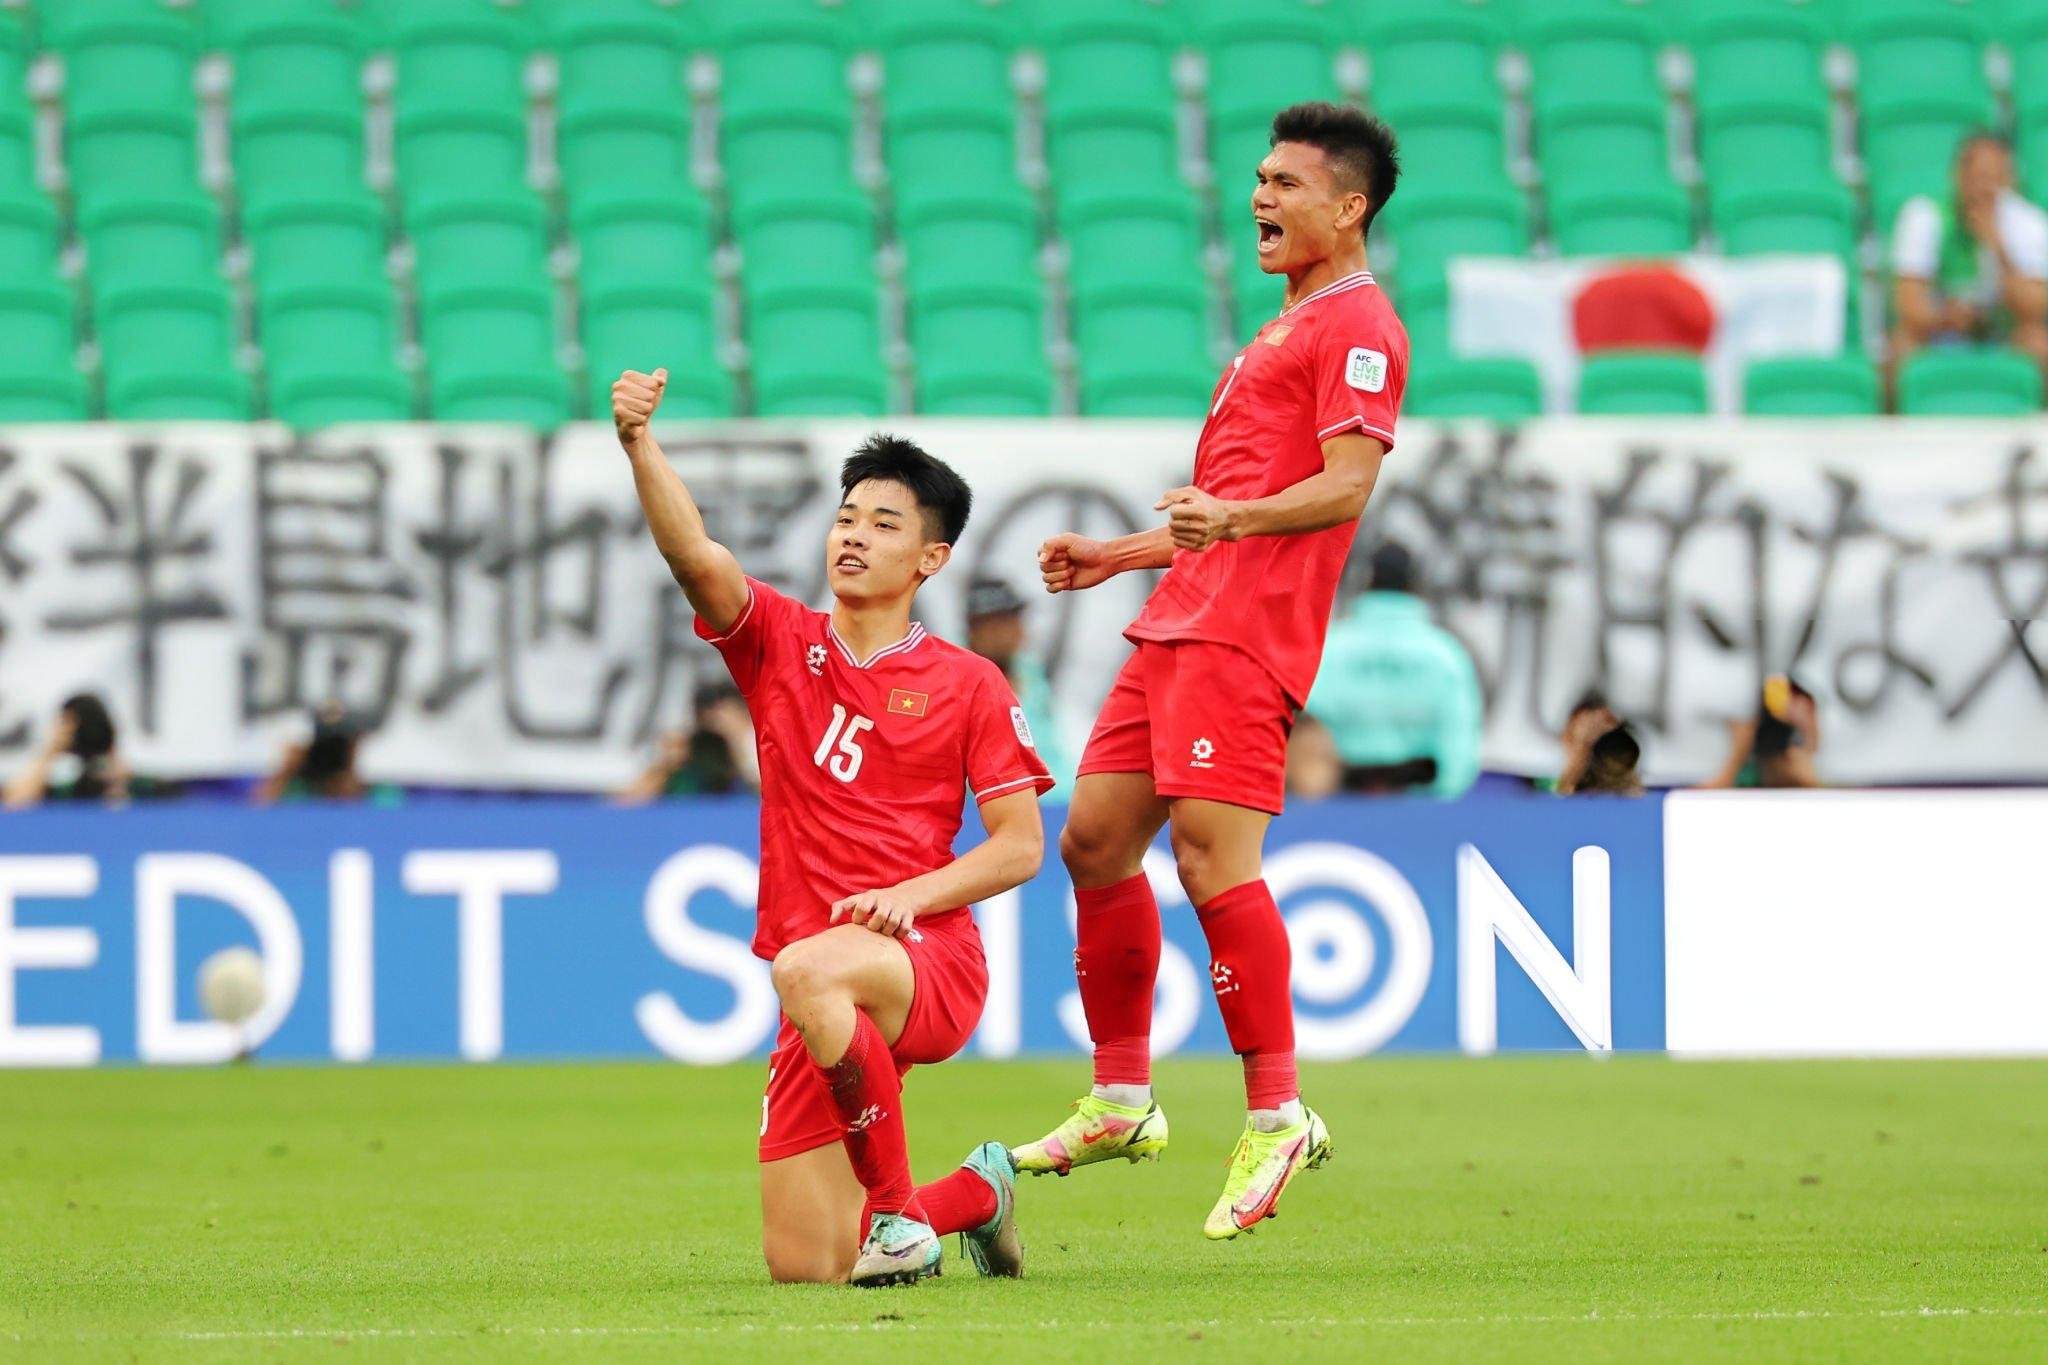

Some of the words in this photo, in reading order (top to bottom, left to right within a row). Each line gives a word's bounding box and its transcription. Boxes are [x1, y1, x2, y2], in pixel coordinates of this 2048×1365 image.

[1355, 354, 1371, 363] AFC
[1354, 361, 1380, 377] LIVE
[813, 703, 875, 783] 15
